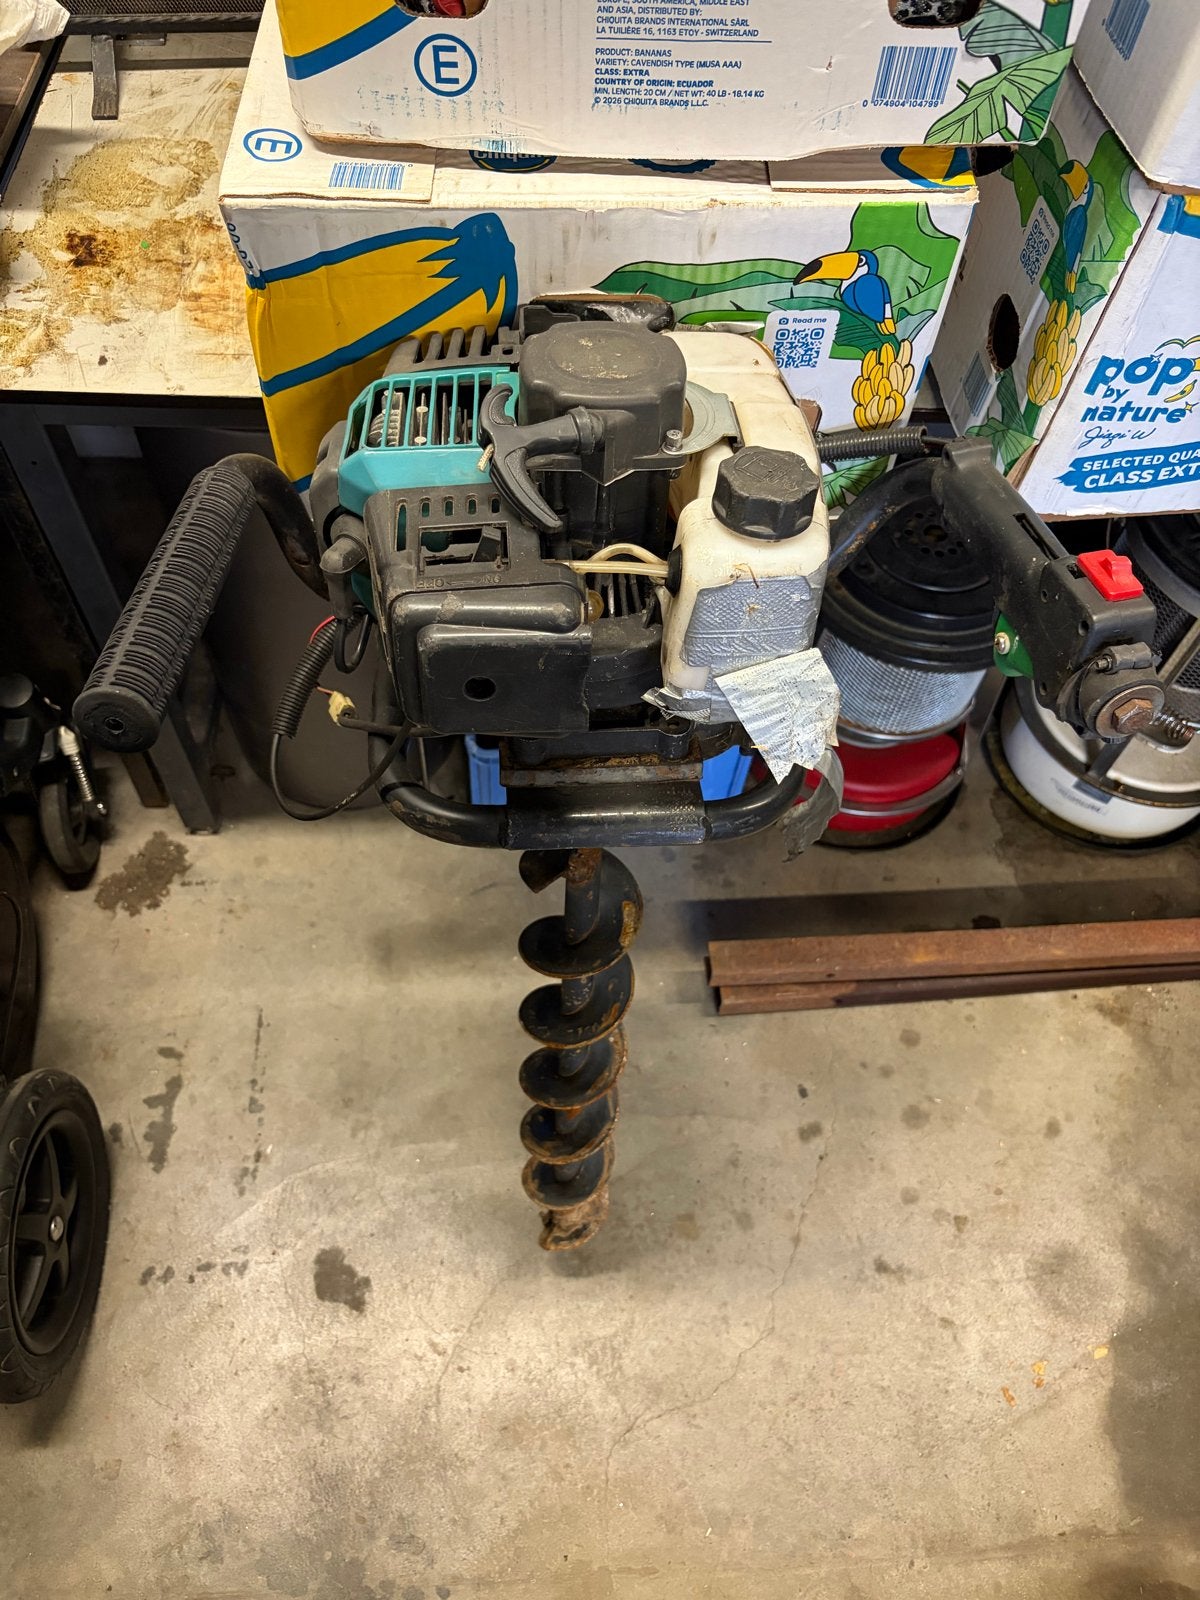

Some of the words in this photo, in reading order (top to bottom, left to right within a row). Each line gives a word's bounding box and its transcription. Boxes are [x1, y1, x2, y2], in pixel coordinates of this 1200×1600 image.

[596, 5, 614, 14] AND
[616, 6, 636, 15] ASIA,
[637, 6, 688, 16] DISTRIBUTED
[596, 16, 633, 24] CHIQUITA
[634, 17, 666, 25] BRANDS
[667, 17, 728, 26] INTERNATIONAL
[596, 26, 606, 34] LA
[643, 27, 655, 36] 16,
[657, 28, 677, 36] 1163
[678, 28, 700, 37] ETOY
[705, 29, 759, 37] SWITZERLAND
[595, 48, 633, 56] PRODUCT:
[634, 49, 672, 58] BANANAS
[432, 44, 460, 85] E
[595, 58, 629, 66] VARIETY:
[630, 59, 673, 67] CAVENDISH
[675, 60, 694, 68] TYPE
[696, 60, 720, 69] (MUSA
[722, 61, 742, 69] AAA)
[595, 68, 621, 76] CLASS:
[623, 69, 650, 77] EXTRA
[594, 77, 632, 86] COUNTRY
[633, 79, 645, 87] OF
[646, 79, 675, 87] ORIGIN:
[676, 80, 714, 88] ECUADOR
[594, 87, 610, 95] MIN.
[611, 88, 642, 96] LENGTH:
[654, 89, 666, 97] CM
[623, 97, 658, 106] CHIQUITA
[659, 99, 690, 107] BRANDS
[1083, 354, 1194, 396] pop
[1102, 385, 1130, 403] by
[1080, 401, 1187, 423] nature
[1082, 454, 1165, 472] SELECTED
[1168, 448, 1200, 464] QUA
[1084, 469, 1155, 489] CLASS
[1157, 462, 1200, 480] EXT
